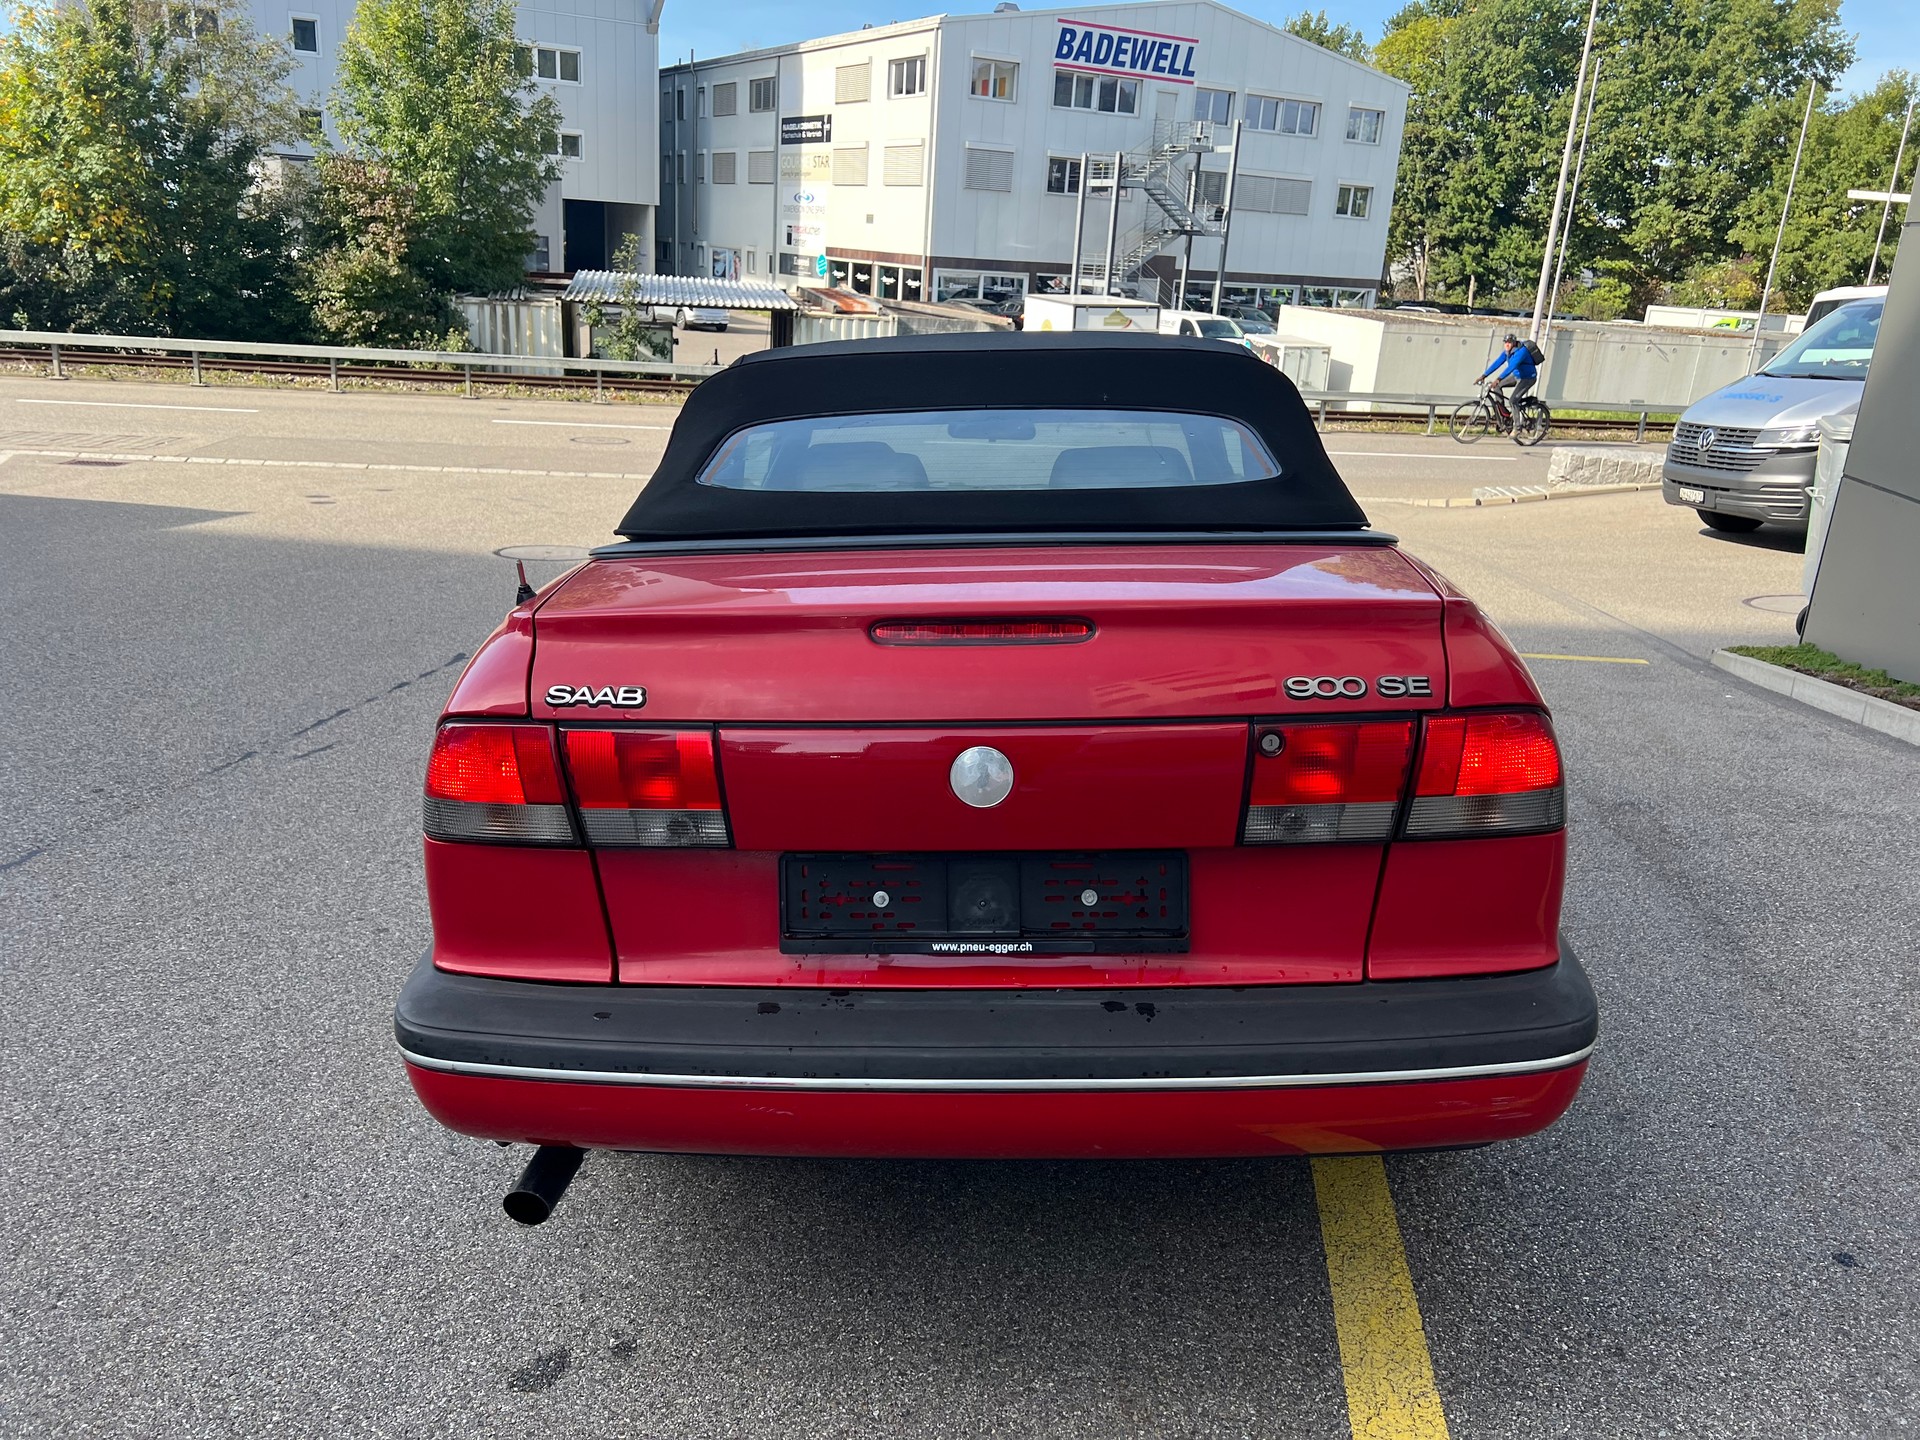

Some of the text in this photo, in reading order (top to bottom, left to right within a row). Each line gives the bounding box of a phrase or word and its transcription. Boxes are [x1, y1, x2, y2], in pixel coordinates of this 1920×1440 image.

[1055, 27, 1195, 77] BADEWELL
[782, 155, 830, 168] GOUR STAR
[545, 685, 646, 707] SAAB
[1285, 676, 1432, 698] 900 SE
[932, 942, 1033, 953] www.pneu-egger.ch
